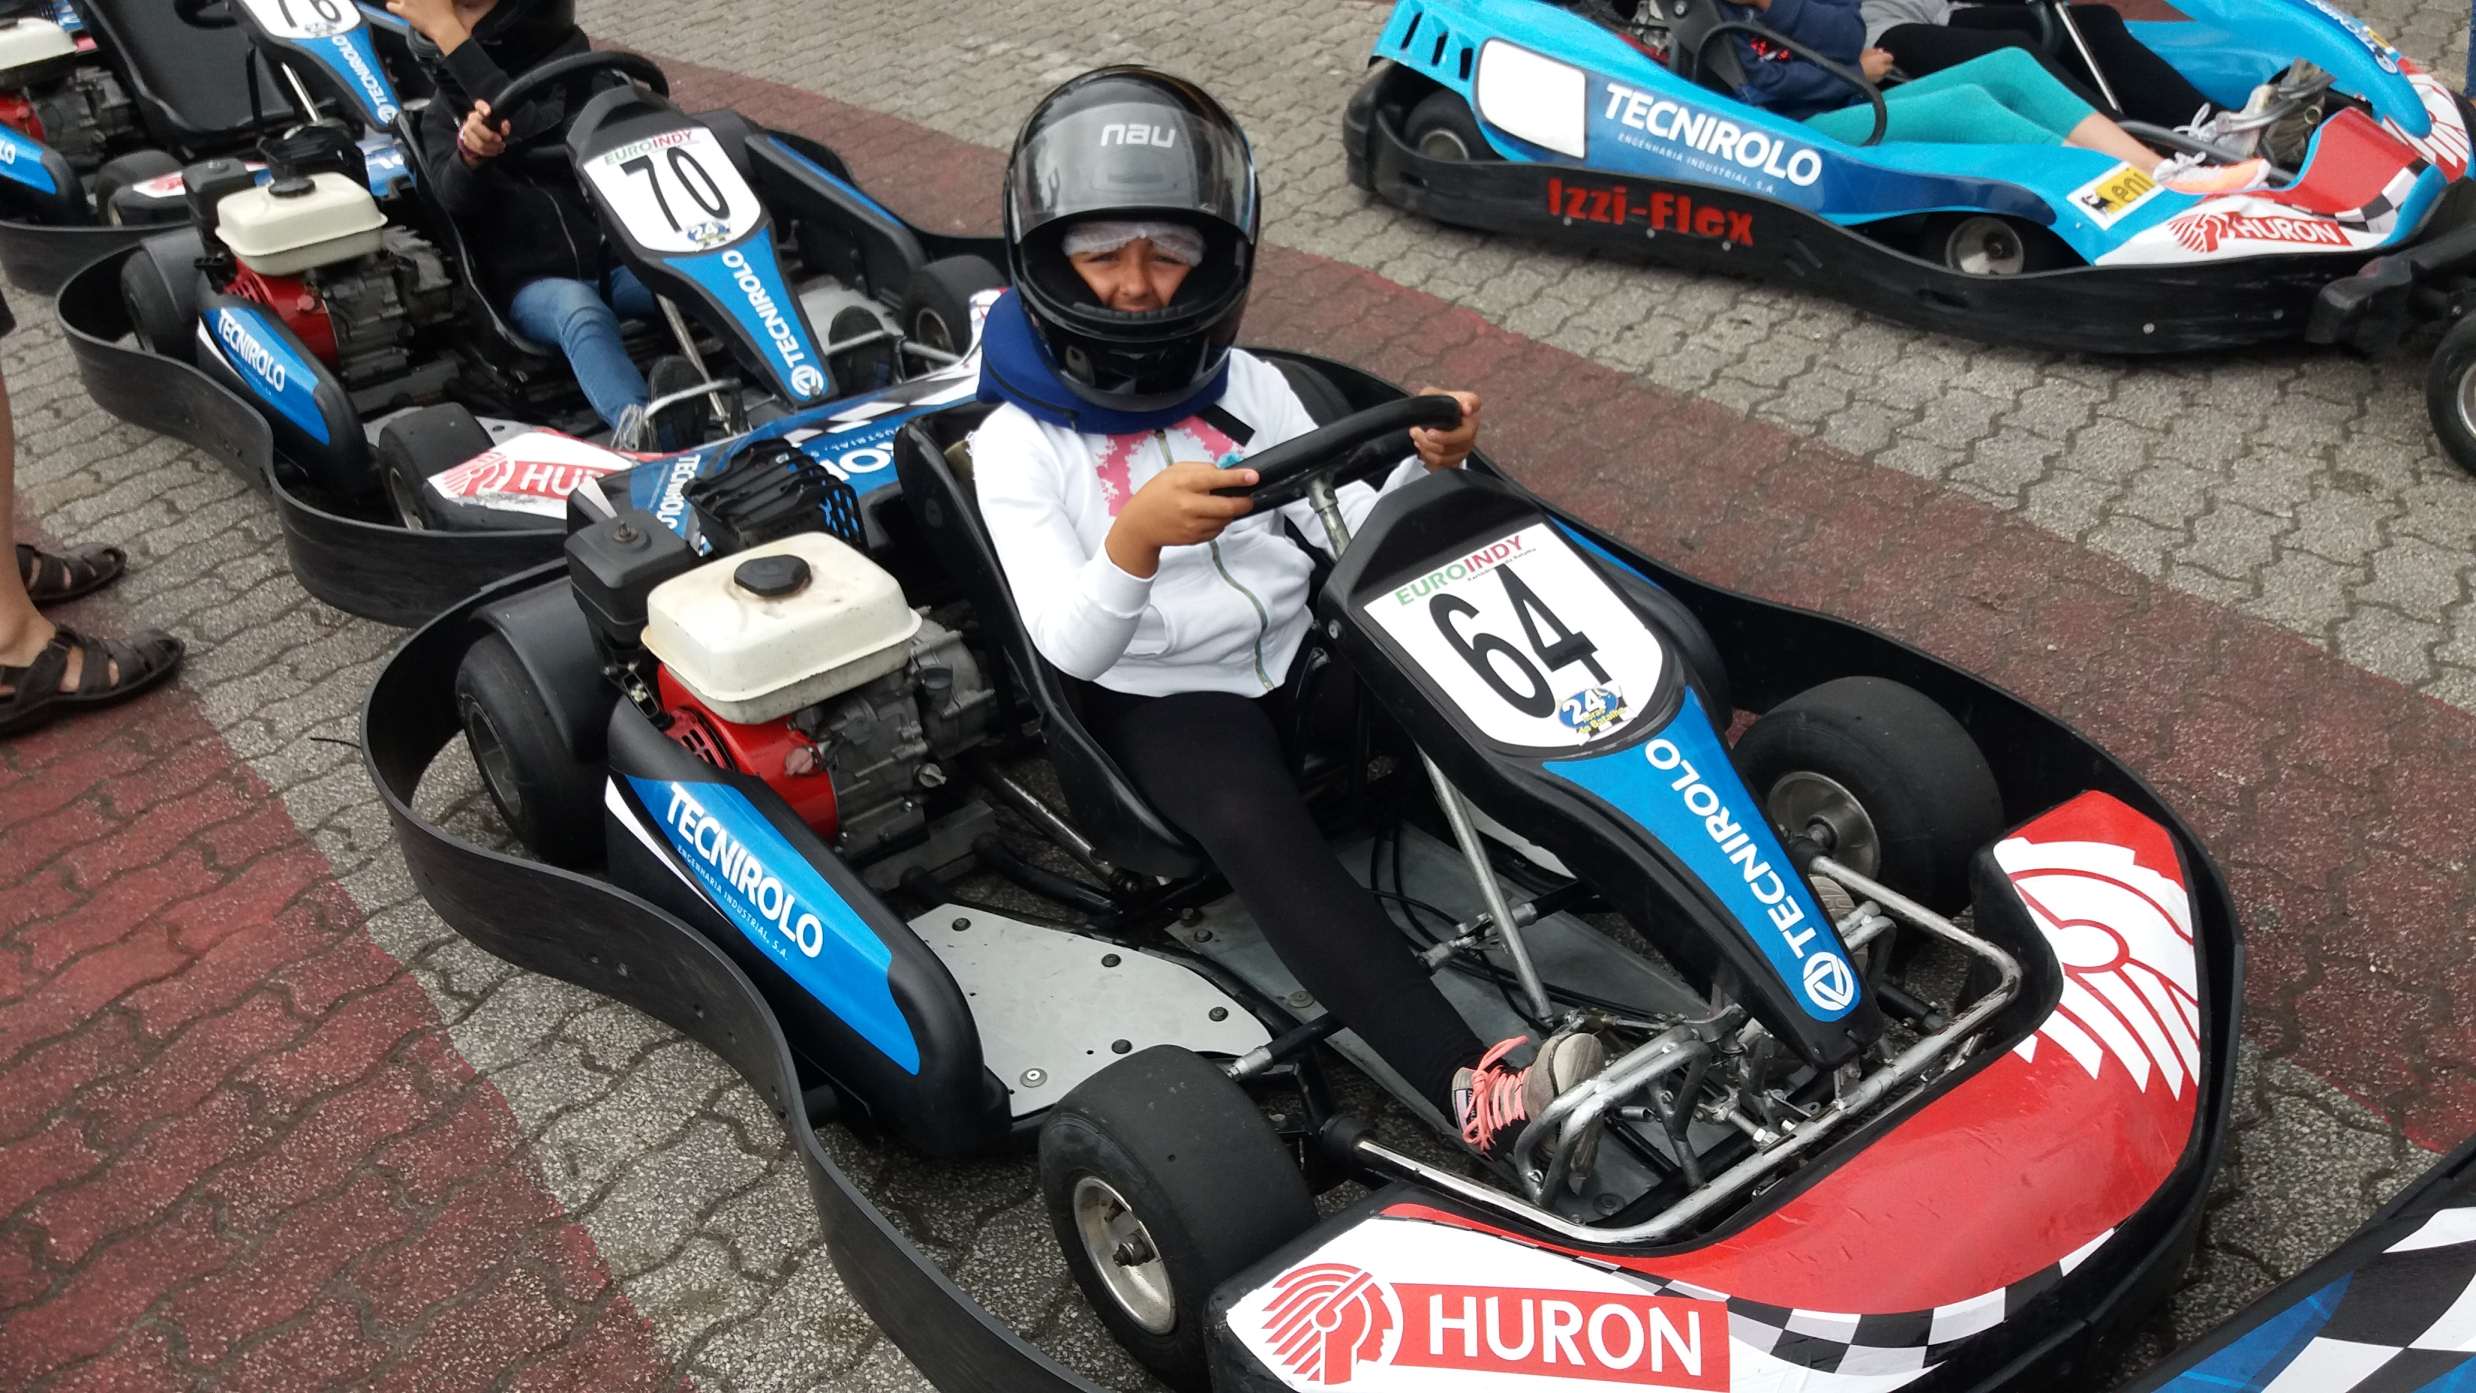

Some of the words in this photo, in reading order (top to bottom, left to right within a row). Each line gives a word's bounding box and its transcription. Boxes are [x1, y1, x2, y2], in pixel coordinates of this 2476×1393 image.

[604, 131, 692, 165] EUROINDY
[1100, 123, 1176, 149] nau
[1605, 83, 1822, 187] TECNIROLO
[620, 146, 731, 233] 70
[1546, 179, 1754, 246] Izzi-Flex
[2233, 215, 2341, 243] HURON
[218, 307, 286, 392] TECNIROLO
[722, 250, 804, 368] TECNIROLO
[1395, 535, 1523, 606] EUROINDY
[1429, 564, 1613, 718] 64
[1562, 689, 1606, 725] 24
[666, 783, 823, 958] TECNIROLO
[1645, 739, 1817, 958] TECNIROLO
[678, 845, 722, 893] ENGENHARIA
[724, 891, 771, 944] INDUSTRIAL,
[1429, 1294, 1702, 1376] HURON
